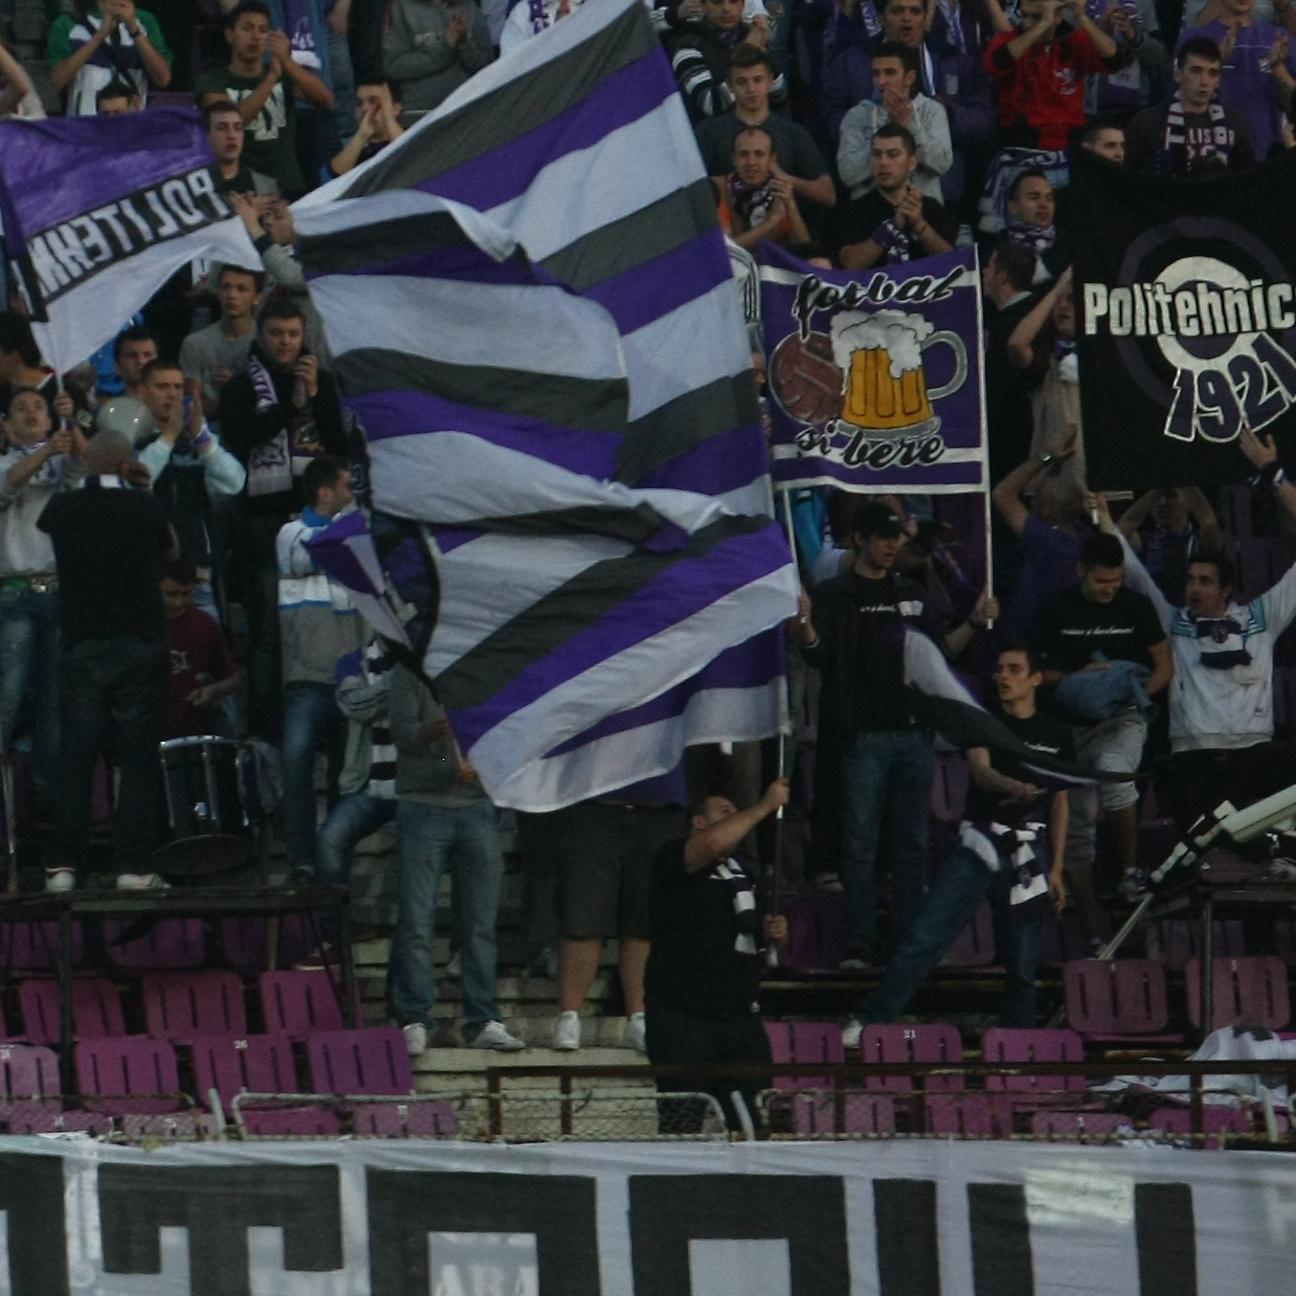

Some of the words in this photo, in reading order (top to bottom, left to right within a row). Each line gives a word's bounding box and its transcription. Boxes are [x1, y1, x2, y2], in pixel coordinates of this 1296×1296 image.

[1083, 278, 1296, 337] Politehnic
[1164, 331, 1296, 443] 1921
[840, 429, 947, 471] bere
